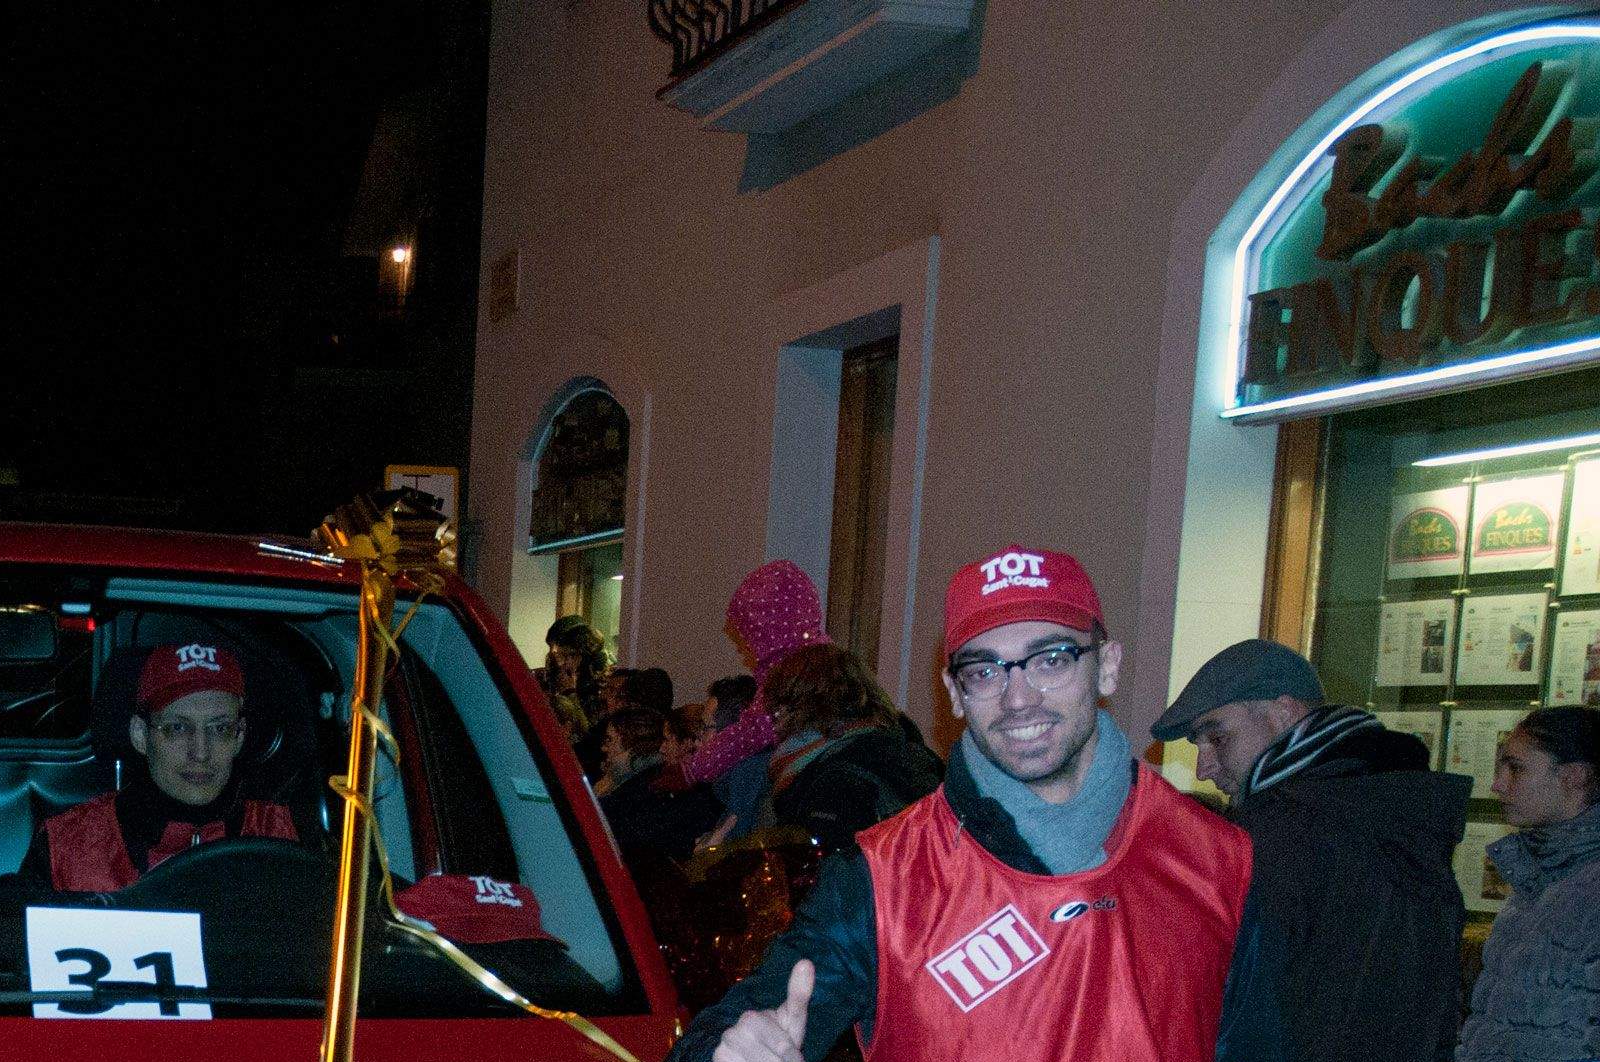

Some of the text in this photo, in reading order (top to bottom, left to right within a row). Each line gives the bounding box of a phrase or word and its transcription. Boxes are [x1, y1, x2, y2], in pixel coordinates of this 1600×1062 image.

[980, 552, 1045, 583] TOT
[175, 643, 217, 662] TOT
[468, 876, 514, 897] TOT
[933, 911, 1036, 1000] TOT
[55, 947, 181, 1017] 31
